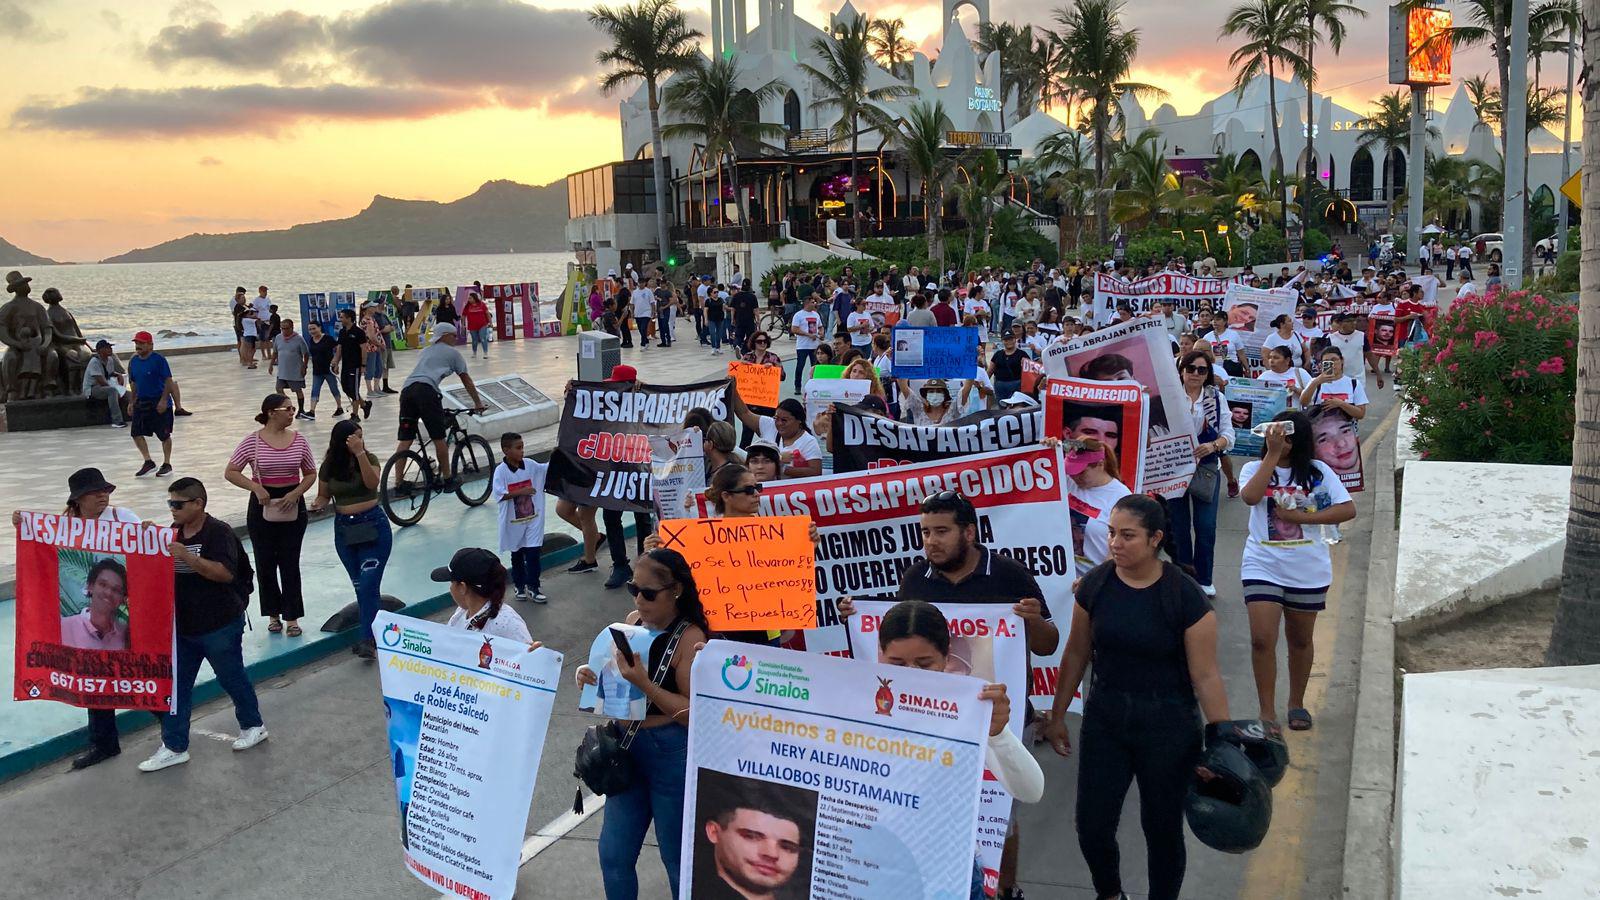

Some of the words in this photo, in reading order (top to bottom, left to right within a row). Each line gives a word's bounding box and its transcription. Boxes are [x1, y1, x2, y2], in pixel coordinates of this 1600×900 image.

[1049, 343, 1080, 357] IROBEL
[1082, 328, 1127, 348] ABRAJAN
[1129, 319, 1163, 334] PETRIZ
[1051, 382, 1139, 402] DESAPARECIDO
[814, 458, 1054, 517] DESAPARECIDOS
[21, 511, 174, 557] DESAPARECIDO
[661, 525, 687, 548] X
[698, 520, 785, 545] JONATAN
[815, 525, 898, 562] XIGIMOS
[716, 576, 731, 593] lo
[995, 619, 1017, 637] A:
[402, 638, 432, 655] Sinaloa
[494, 657, 521, 671] SINALOA
[50, 671, 73, 689] 667
[77, 679, 106, 693] 157
[111, 680, 157, 693] 1930
[388, 654, 452, 681] Ayúdanos
[450, 672, 456, 682] a
[459, 675, 514, 699] encontrar
[514, 690, 521, 700] a
[431, 682, 451, 697] José
[453, 685, 478, 704] Ángel
[755, 678, 810, 701] Sinaloa
[414, 691, 426, 704] de
[427, 695, 456, 712] Robles
[458, 703, 489, 722] Salcedo
[899, 693, 959, 713] SINALOA
[424, 712, 451, 726] Municipio
[453, 720, 462, 729] del
[462, 724, 479, 736] hecho:
[926, 710, 937, 718] DEL
[937, 712, 959, 720] ESTADO
[423, 721, 449, 735] Mazatlán
[721, 707, 820, 739] Ayúdanos
[825, 728, 836, 744] a
[842, 731, 936, 761] encontrar
[942, 752, 954, 767] a
[420, 744, 436, 754] Edad:
[421, 733, 436, 744] Sexo:
[437, 738, 459, 752] Hombre
[417, 762, 428, 772] Tez:
[770, 741, 807, 760] NERY
[809, 751, 891, 778] ALEJANDRO
[737, 759, 820, 788] VILLALOBOS
[824, 777, 920, 810] BUSTAMANTE
[413, 790, 427, 801] Ojos:
[428, 796, 448, 810] Grandes
[449, 806, 462, 814] color
[821, 794, 836, 803] Fecha
[819, 813, 845, 823] Municipio
[431, 819, 446, 831] Corto
[447, 826, 460, 836] color
[461, 832, 477, 844] negro
[441, 841, 457, 855] labios
[456, 851, 481, 866] delgados
[446, 877, 453, 891] LO
[466, 865, 474, 873] en
[474, 868, 494, 881] ambas
